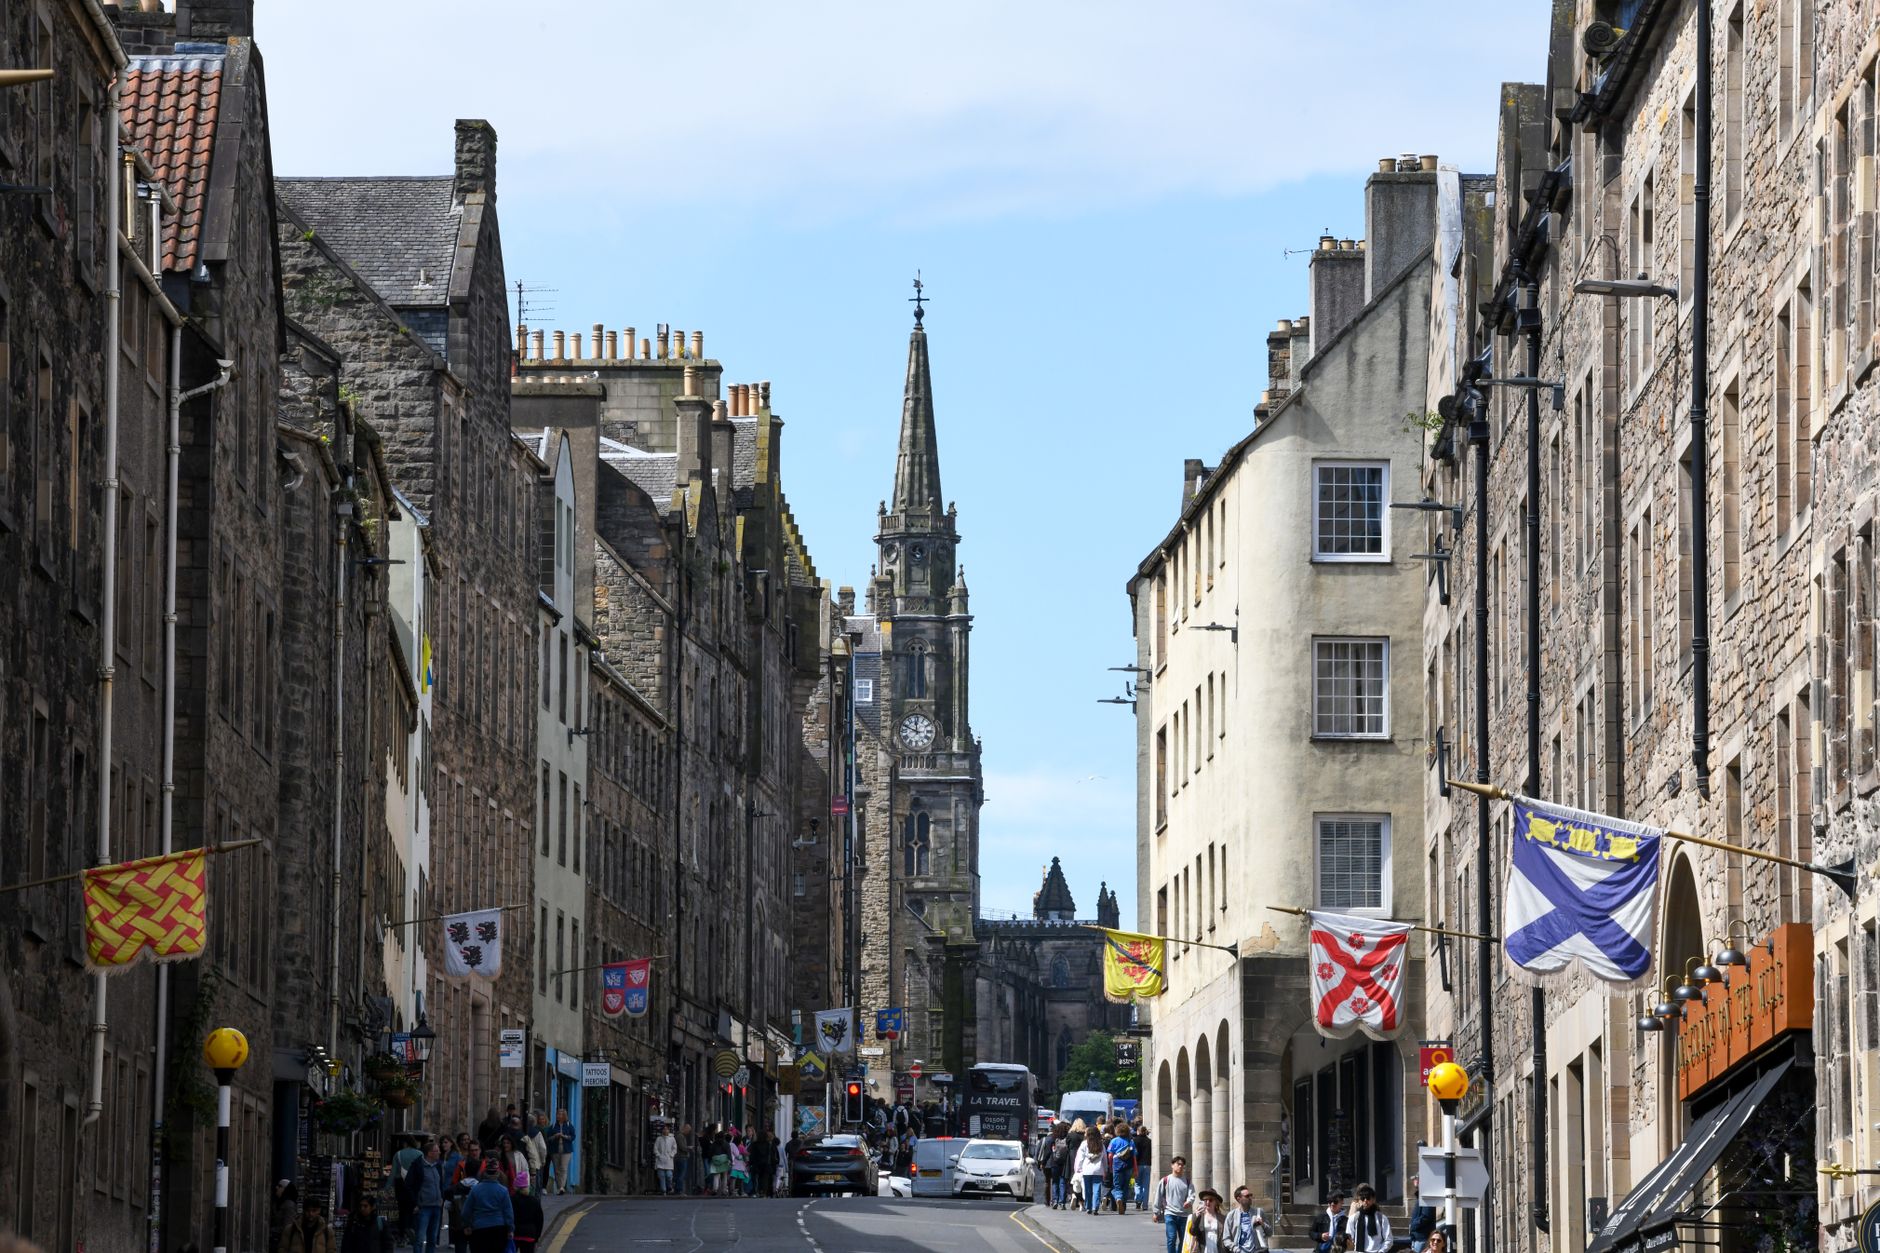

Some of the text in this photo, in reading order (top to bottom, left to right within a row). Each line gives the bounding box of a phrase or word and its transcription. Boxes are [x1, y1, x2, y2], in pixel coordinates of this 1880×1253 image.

[585, 1068, 607, 1076] TATTOOS
[970, 1096, 1021, 1105] LA TRAVEL
